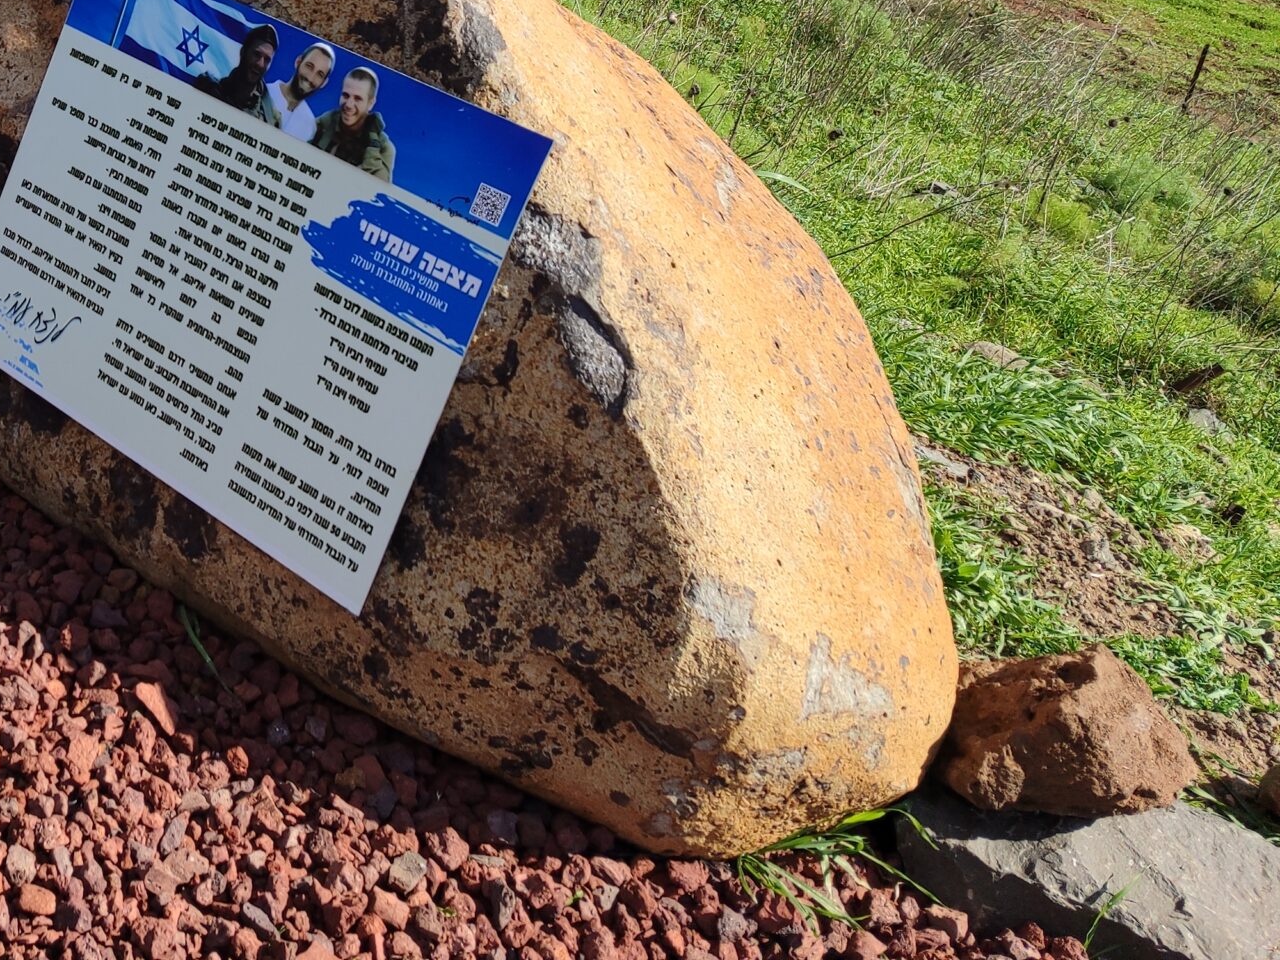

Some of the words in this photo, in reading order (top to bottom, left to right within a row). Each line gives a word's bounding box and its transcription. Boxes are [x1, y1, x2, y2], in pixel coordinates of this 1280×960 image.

[216, 121, 229, 133] יום
[209, 159, 225, 174] עזה
[243, 176, 257, 191] של
[278, 194, 291, 208] על
[289, 201, 308, 218] נפש
[210, 224, 223, 237] יום
[237, 217, 252, 232] את
[168, 243, 182, 257] את
[359, 219, 420, 264] עמיחי
[211, 246, 224, 260] כח
[168, 263, 180, 277] אל
[244, 263, 258, 280] בהר
[273, 259, 286, 273] הם
[351, 254, 376, 273] ועולה
[375, 267, 416, 295] המתגברת
[401, 265, 439, 293] ממשיכים
[418, 251, 482, 298] מצפה
[129, 282, 145, 299] אחד
[146, 293, 157, 306] כל
[313, 282, 343, 305] שלושה
[343, 297, 362, 316] לזכר
[416, 289, 448, 313] באמונה
[210, 311, 222, 325] בה
[319, 306, 338, 326] ברזל
[359, 308, 386, 330] בקשת
[336, 318, 362, 340] חרבות
[385, 322, 410, 343] מצפה
[360, 331, 391, 356] מלחמת
[408, 335, 435, 357] הקמנו
[143, 356, 156, 370] עם
[344, 345, 364, 365] רובין
[390, 348, 419, 372] מגיבורי
[338, 365, 356, 383] ונינו
[364, 356, 388, 377] עמיחי
[118, 383, 130, 396] עם
[331, 384, 348, 401] ויצן
[355, 374, 379, 396] עמיחי
[261, 387, 283, 406] קשת
[347, 393, 371, 414] עמיחי
[144, 400, 158, 416] כאן
[189, 407, 206, 425] התל
[216, 404, 231, 419] את
[255, 405, 270, 421] של
[282, 400, 310, 423] למושב
[182, 425, 196, 441] בתי
[272, 416, 299, 441] המזרחי
[310, 417, 335, 440] הסמוך
[241, 442, 264, 464] מקומו
[302, 434, 325, 457] הגבול
[355, 444, 373, 464] בתל
[263, 457, 278, 472] את
[327, 450, 340, 466] על
[234, 460, 262, 485] ושמירה
[276, 465, 298, 485] קשת
[374, 457, 397, 479] בחרנו
[227, 478, 258, 505] כתשובה
[260, 478, 286, 501] כמענה
[297, 479, 320, 500] מושב
[365, 475, 390, 498] וצופה
[256, 498, 284, 523] המדינה
[296, 501, 314, 519] לפני
[319, 493, 337, 511] נטע
[336, 504, 346, 517] זו
[283, 515, 297, 532] של
[312, 512, 331, 531] שנה
[329, 523, 342, 538] 50
[345, 510, 374, 536] באדמה
[297, 524, 325, 551] המזרחי
[340, 531, 367, 555] הקבוע
[324, 542, 347, 566] הגבול
[347, 557, 360, 573] על
